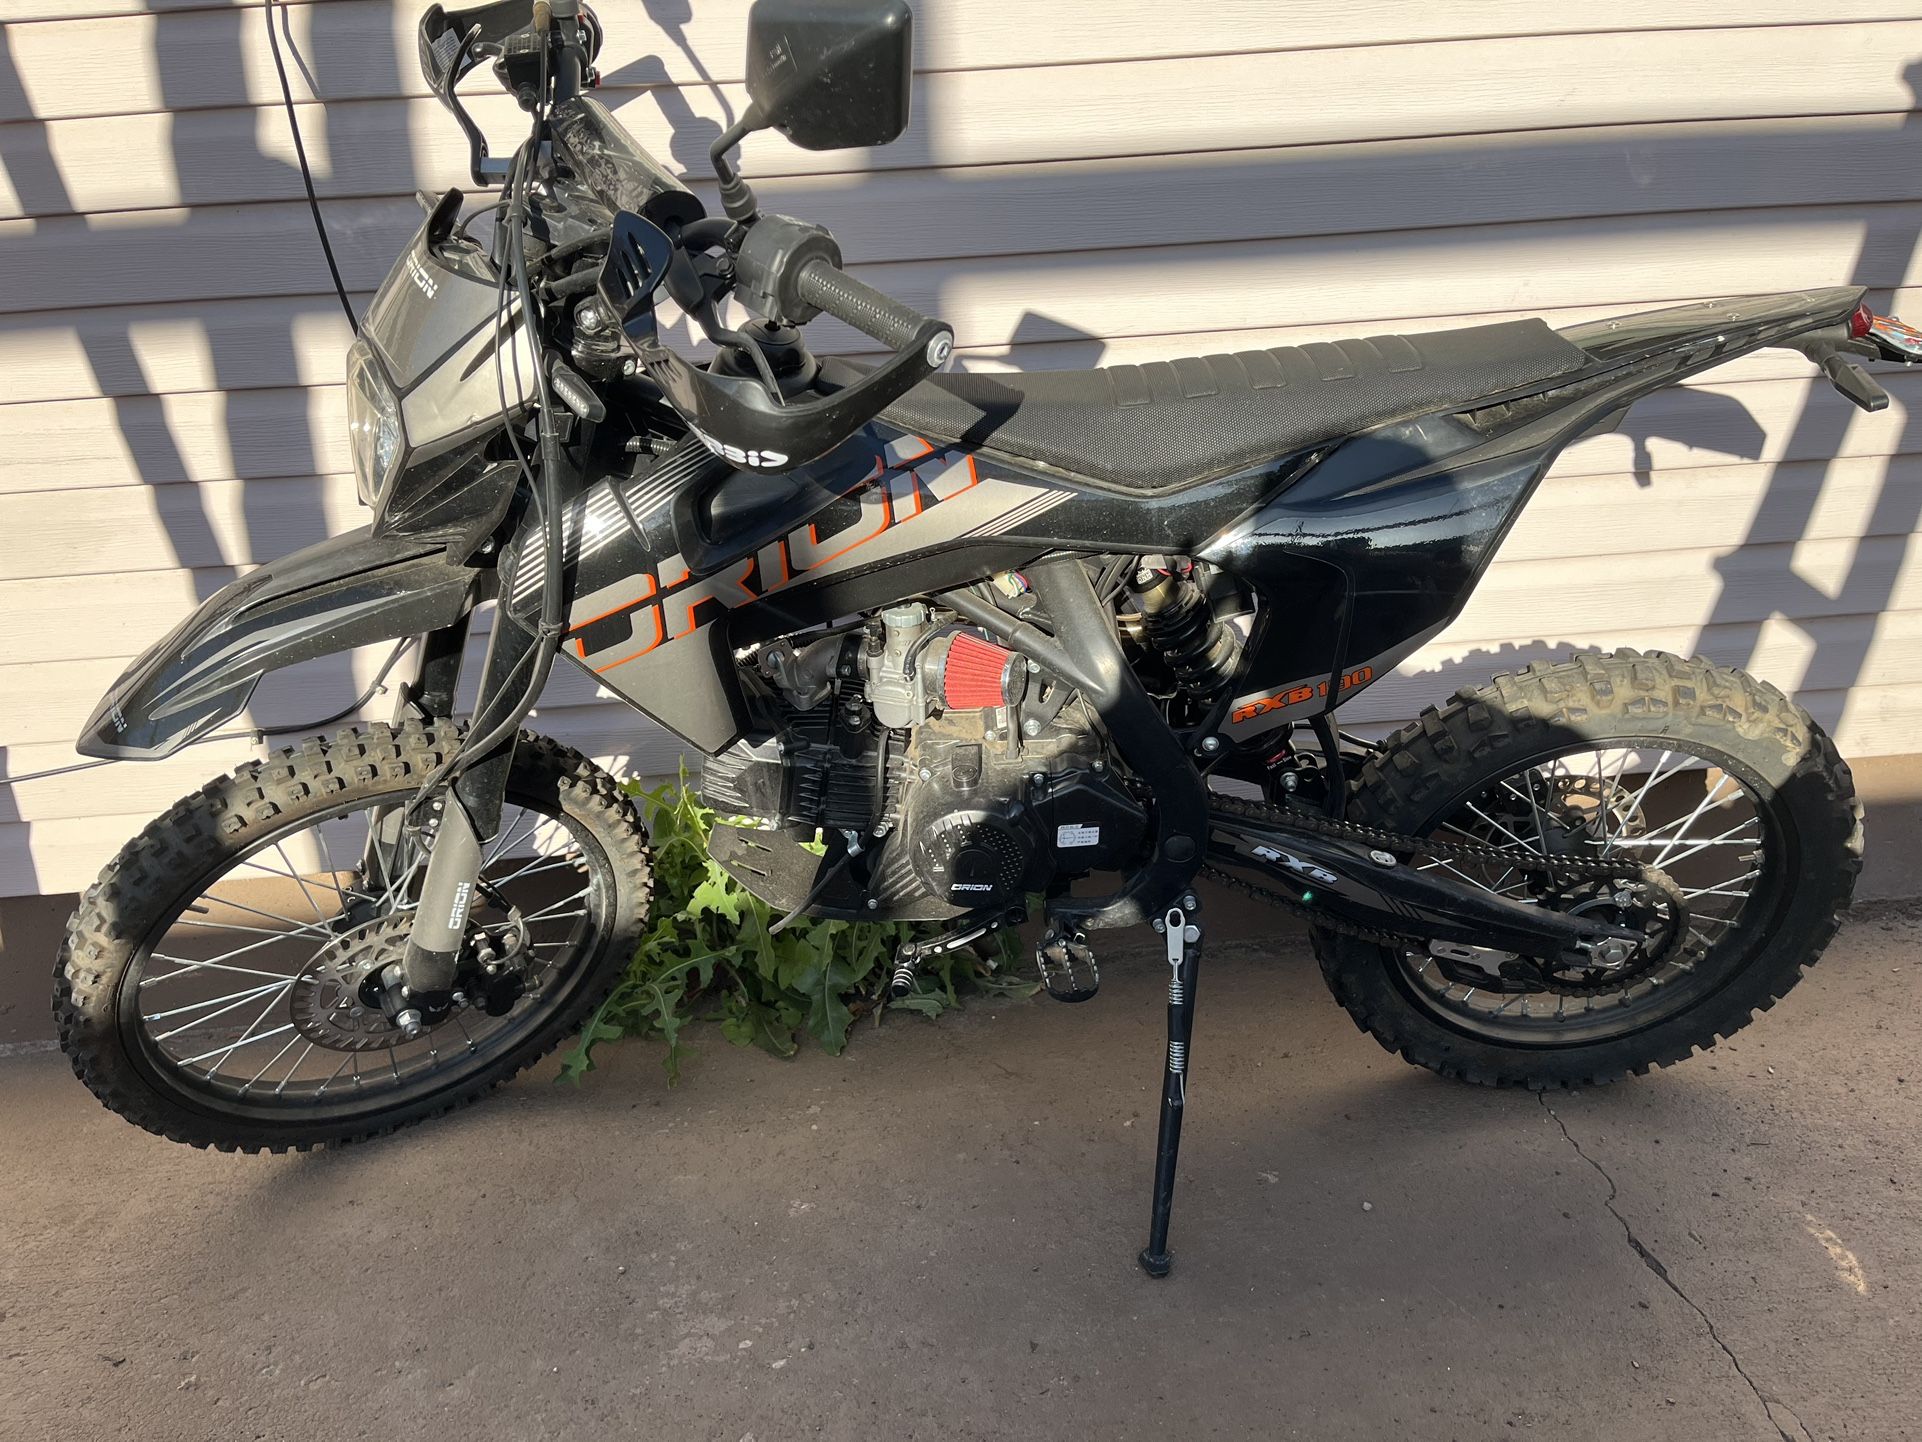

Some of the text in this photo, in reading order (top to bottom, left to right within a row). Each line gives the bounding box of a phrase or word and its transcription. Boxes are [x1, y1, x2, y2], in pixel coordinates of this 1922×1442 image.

[406, 250, 439, 299] RION
[561, 434, 979, 674] ORION
[448, 881, 471, 930] ORION
[950, 883, 993, 892] ORION
